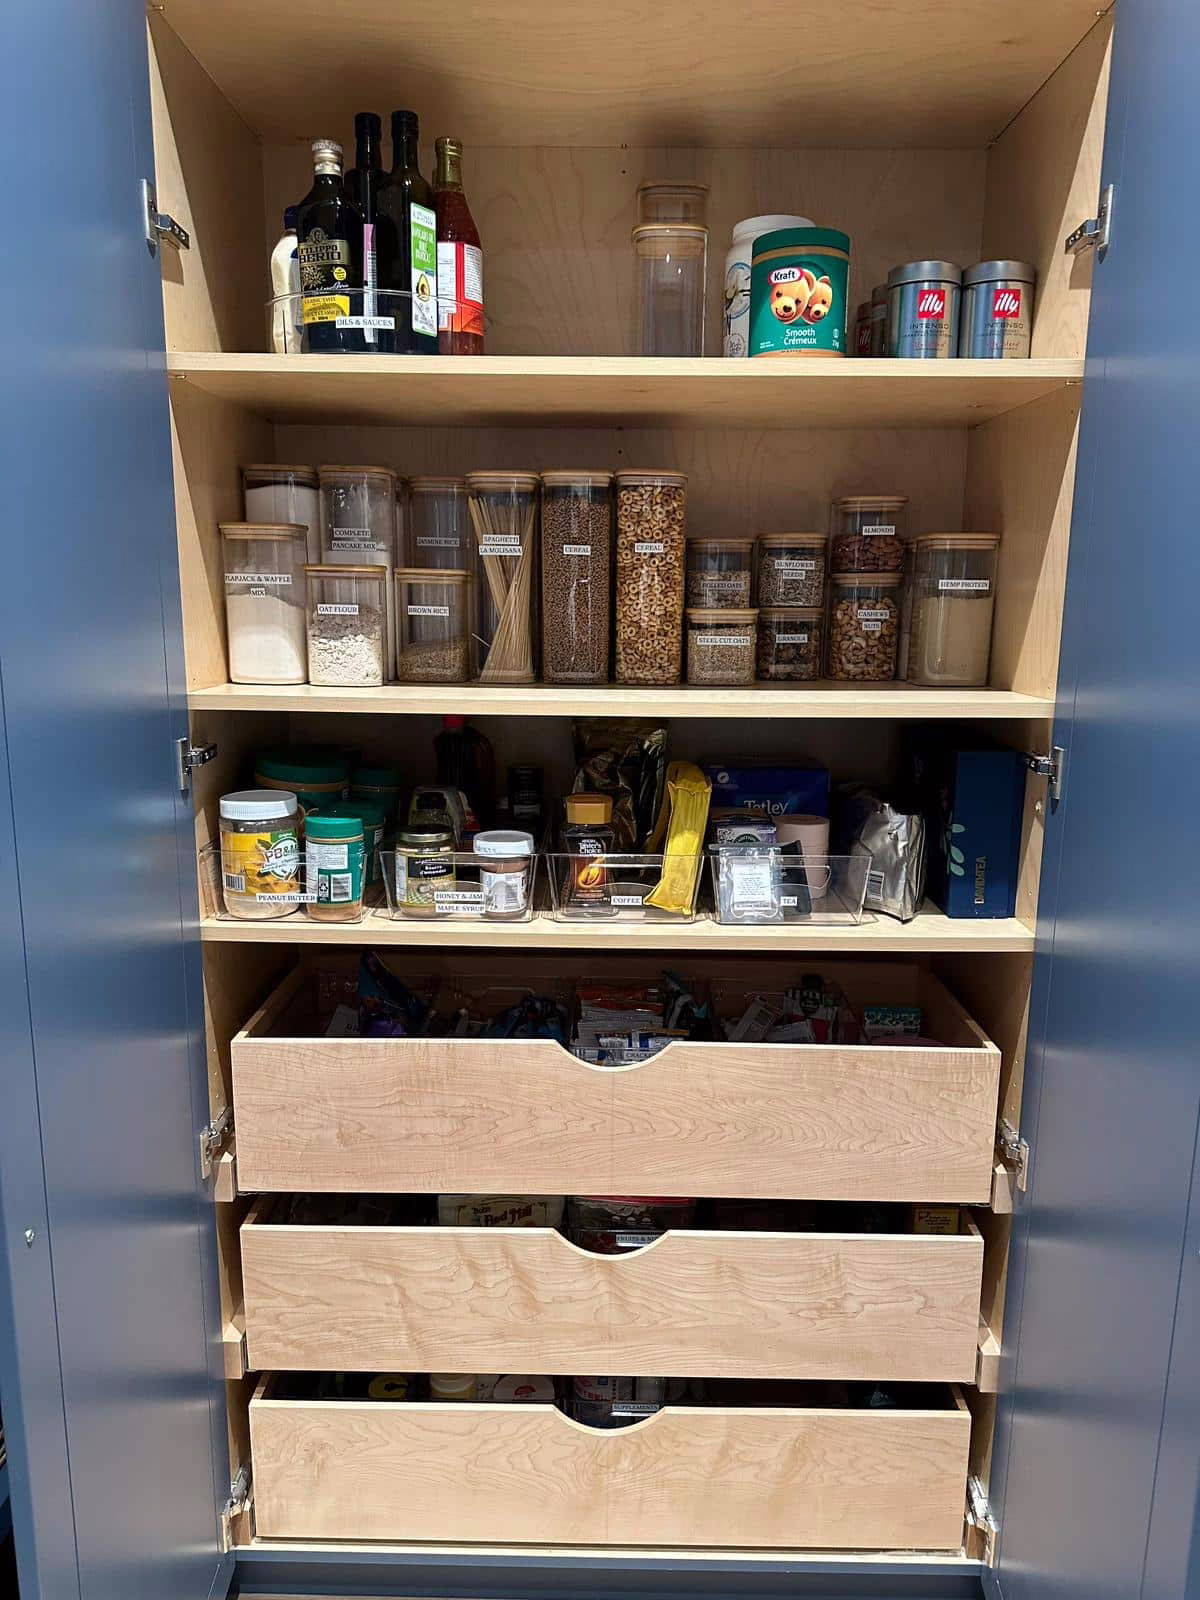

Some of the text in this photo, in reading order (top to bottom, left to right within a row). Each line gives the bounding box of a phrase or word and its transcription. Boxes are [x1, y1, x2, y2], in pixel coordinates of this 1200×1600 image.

[299, 252, 341, 263] BERIO
[774, 270, 797, 281] Kraft
[919, 293, 944, 315] illy
[994, 292, 1019, 315] illy
[337, 318, 353, 326] OILS
[362, 319, 393, 327] SAUCES
[909, 322, 950, 330] INTENSO
[785, 328, 816, 337] Smooth
[783, 336, 817, 345] Crémeux
[484, 536, 519, 544] SPAGHETTI
[489, 547, 522, 555] MOLISANA
[564, 546, 591, 554] CEREAL
[636, 544, 663, 552] CEREAL
[775, 560, 814, 569] SUNFLOWER
[263, 575, 290, 583] WAFFLE
[961, 581, 988, 589] PROTEIN
[432, 607, 449, 615] RICE
[732, 637, 749, 645] OATS
[436, 892, 461, 900] HONEY
[468, 893, 483, 901] JAM
[437, 904, 485, 913] MAPLE SYRUP
